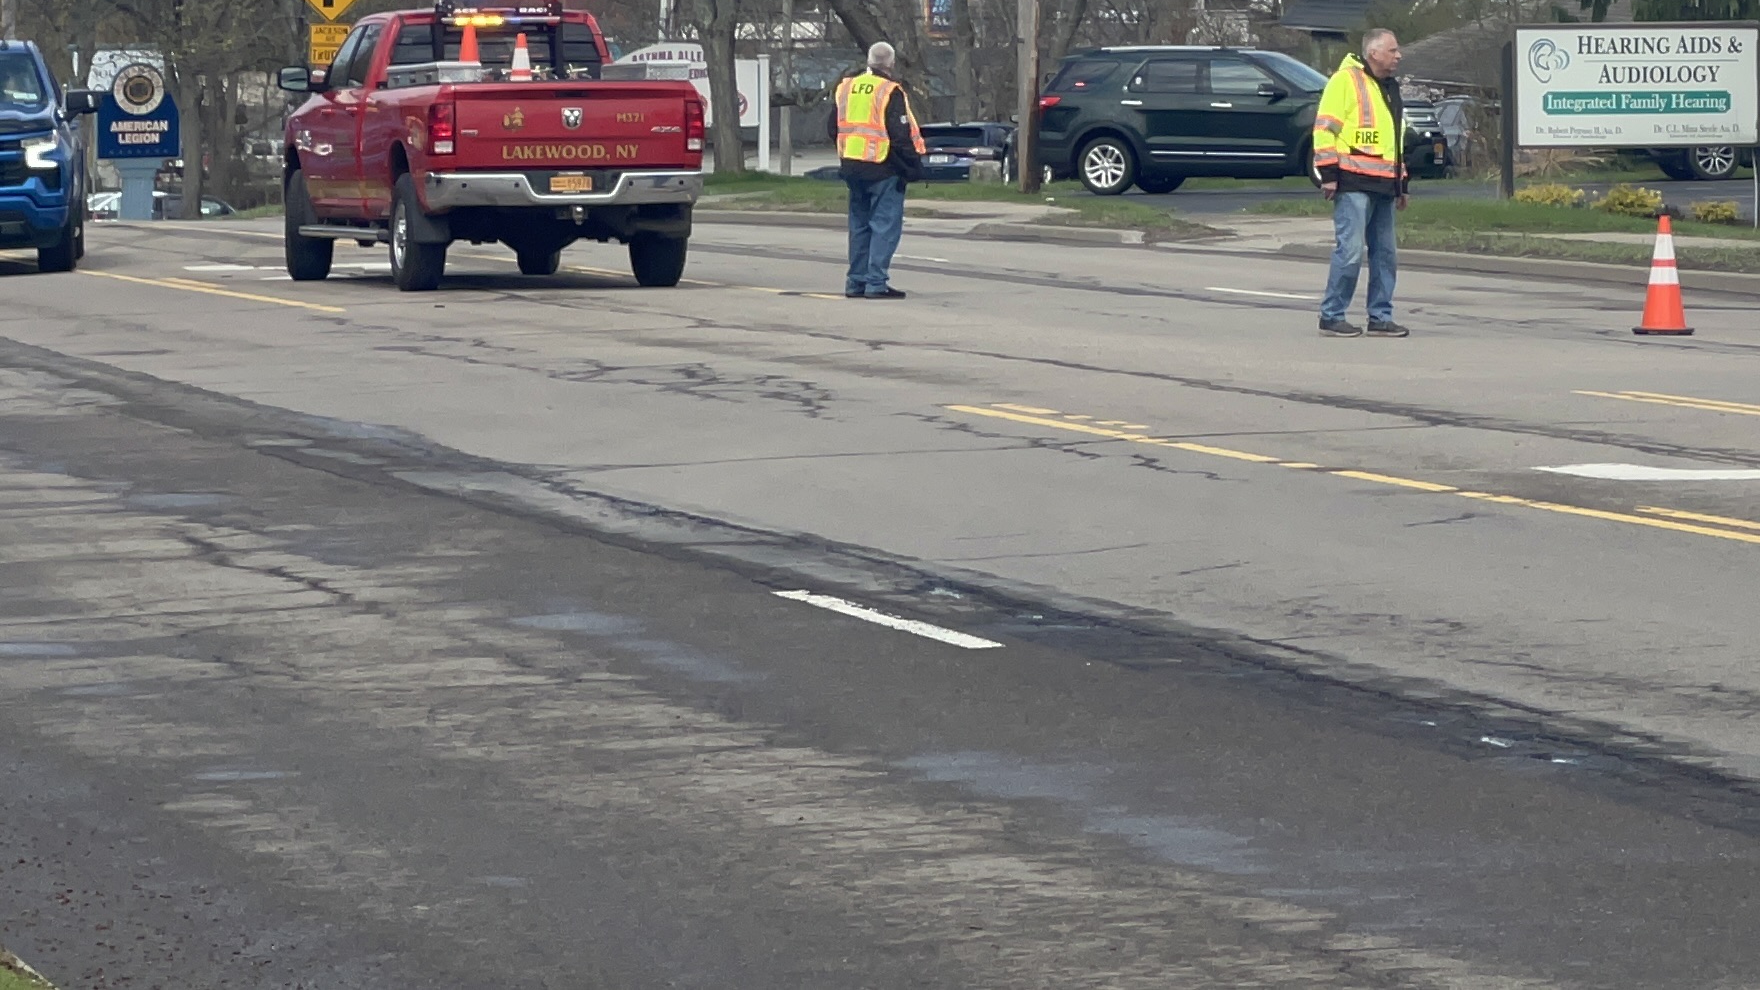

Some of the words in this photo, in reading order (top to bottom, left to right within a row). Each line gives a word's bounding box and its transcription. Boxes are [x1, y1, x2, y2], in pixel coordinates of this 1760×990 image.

[1577, 35, 1671, 54] HEARING
[1675, 35, 1722, 54] AIDS
[1727, 36, 1743, 53] &
[1598, 63, 1720, 84] AUDIOLOGY
[852, 84, 874, 95] LFD
[1547, 93, 1617, 111] Integrated
[1620, 93, 1667, 111] Family
[1670, 92, 1726, 111] Hearing
[616, 112, 645, 123] M371
[110, 121, 168, 132] AMERICAN
[118, 133, 160, 144] LEGION
[1355, 131, 1379, 144] FIRE
[502, 144, 611, 160] LAKEWOOD,
[616, 144, 639, 158] NY
